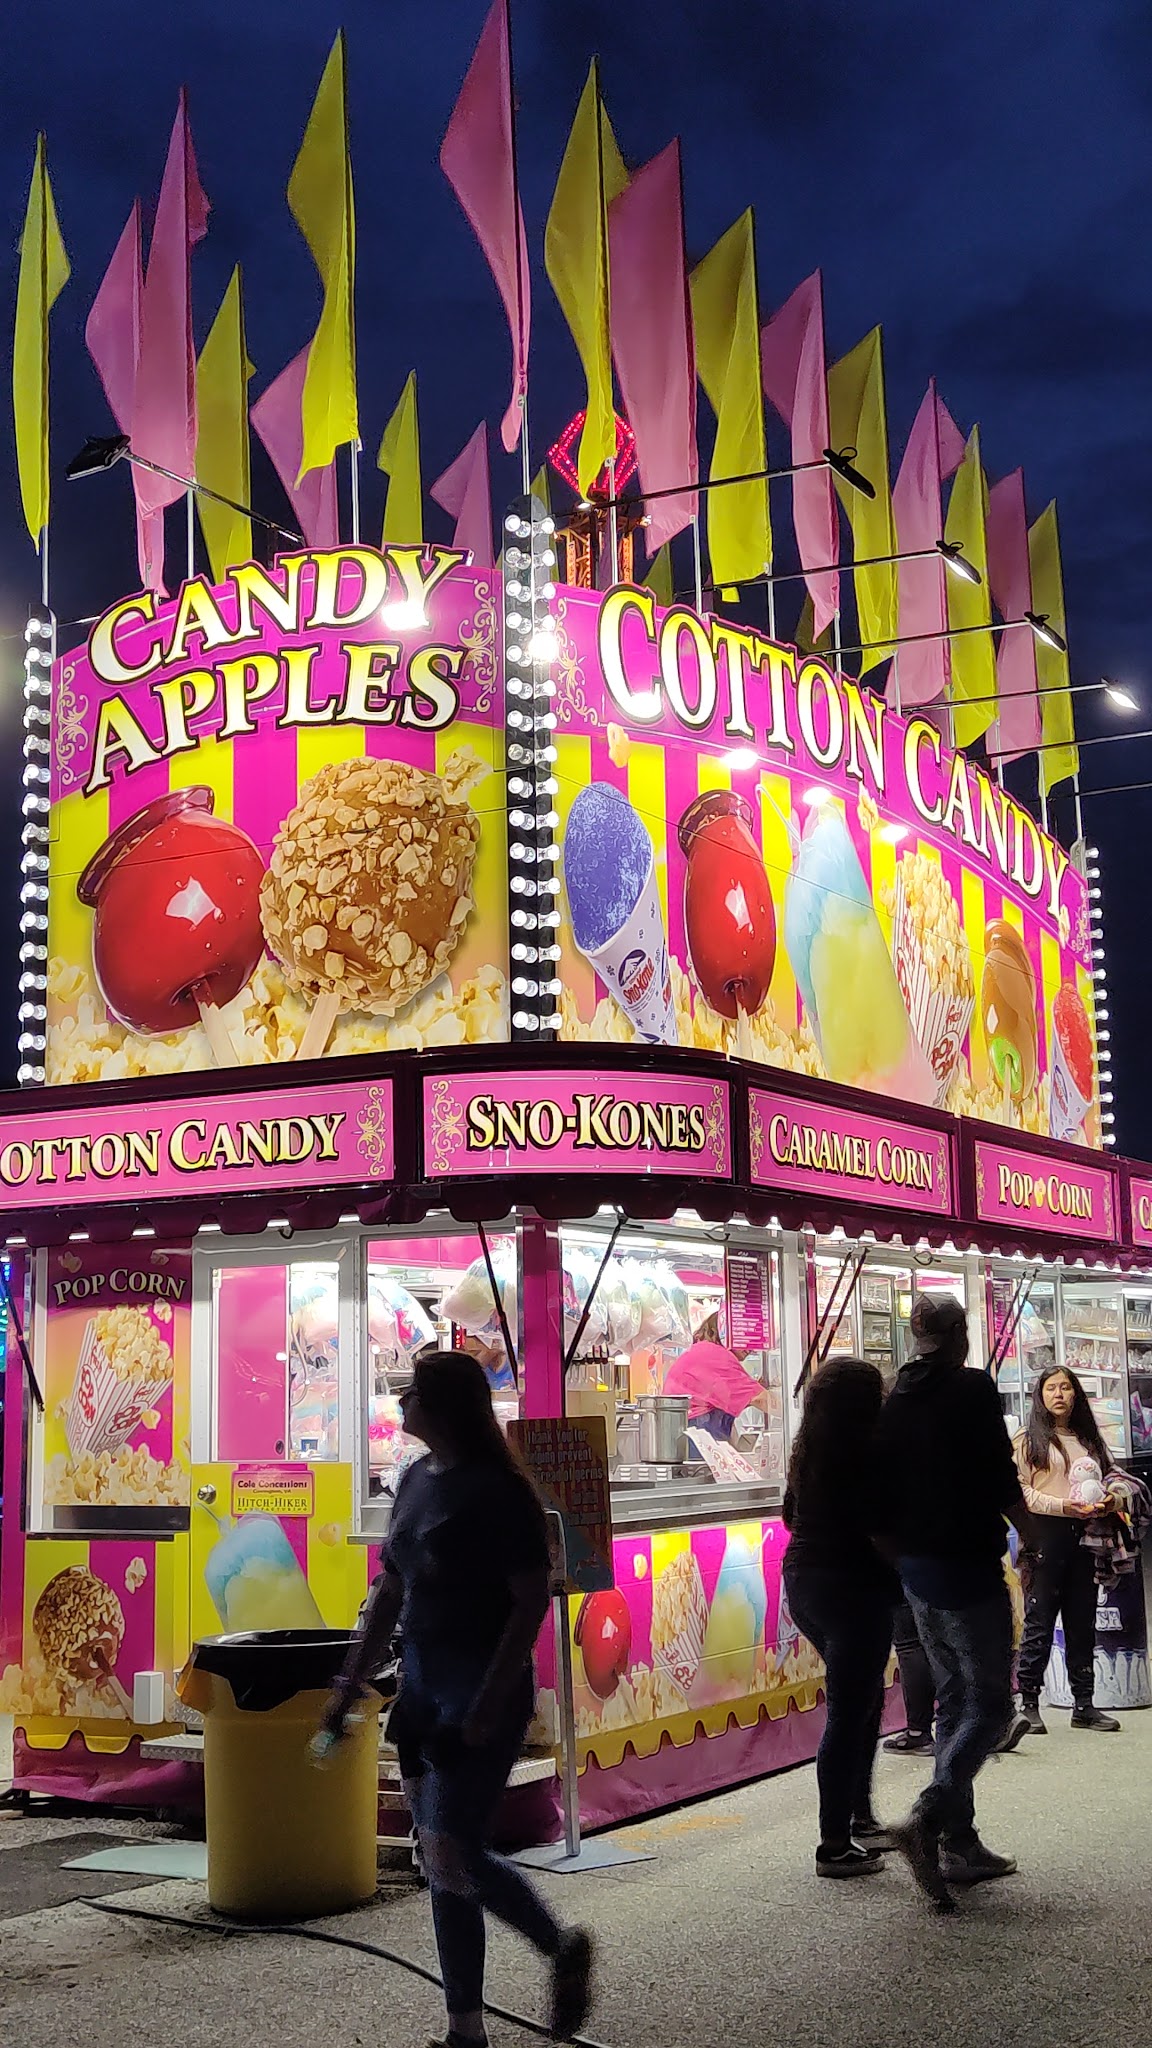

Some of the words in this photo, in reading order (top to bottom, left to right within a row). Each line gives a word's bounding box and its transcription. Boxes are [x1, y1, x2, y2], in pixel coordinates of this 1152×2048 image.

[87, 544, 467, 686] CANDY
[83, 643, 471, 797] APPLES
[600, 582, 887, 792] COTTON
[903, 715, 1072, 919] CANDY
[0, 1130, 162, 1186] OTTON
[169, 1113, 347, 1173] CANDY
[466, 1094, 707, 1151] SNO-KONES
[769, 1114, 877, 1179] CARAMEL
[876, 1137, 934, 1192] CORN
[997, 1163, 1034, 1210] POP
[1046, 1175, 1094, 1220] CORN
[53, 1273, 106, 1306] POP
[109, 1268, 187, 1300] CORN
[528, 1431, 552, 1445] Thank
[556, 1430, 572, 1444] You
[557, 1446, 592, 1465] prevent
[237, 1480, 256, 1488] Cole
[258, 1479, 308, 1488] Concessions
[237, 1497, 308, 1508] HITCH-HIKER
[575, 1468, 603, 1484] germs
